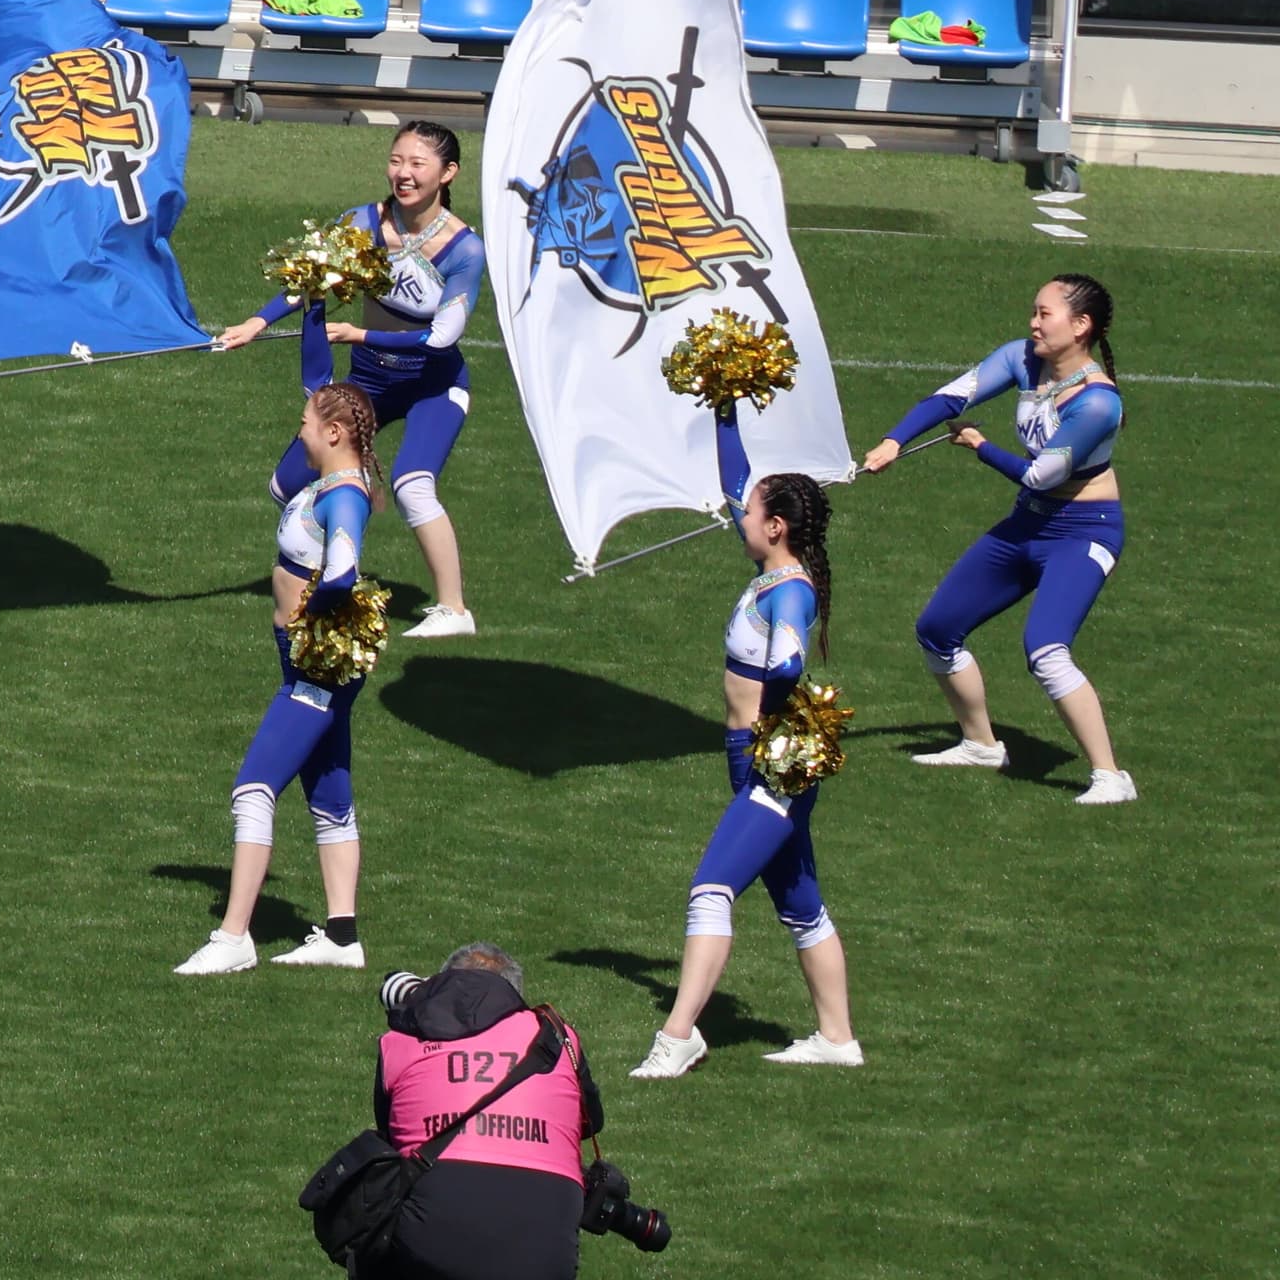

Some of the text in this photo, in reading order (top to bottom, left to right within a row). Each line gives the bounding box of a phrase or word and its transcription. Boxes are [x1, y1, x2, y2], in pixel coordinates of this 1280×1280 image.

[612, 86, 761, 263] KNIGHTS
[628, 174, 715, 310] WILD
[564, 1037, 579, 1070] Canon
[476, 1113, 549, 1145] OFFICIAL
